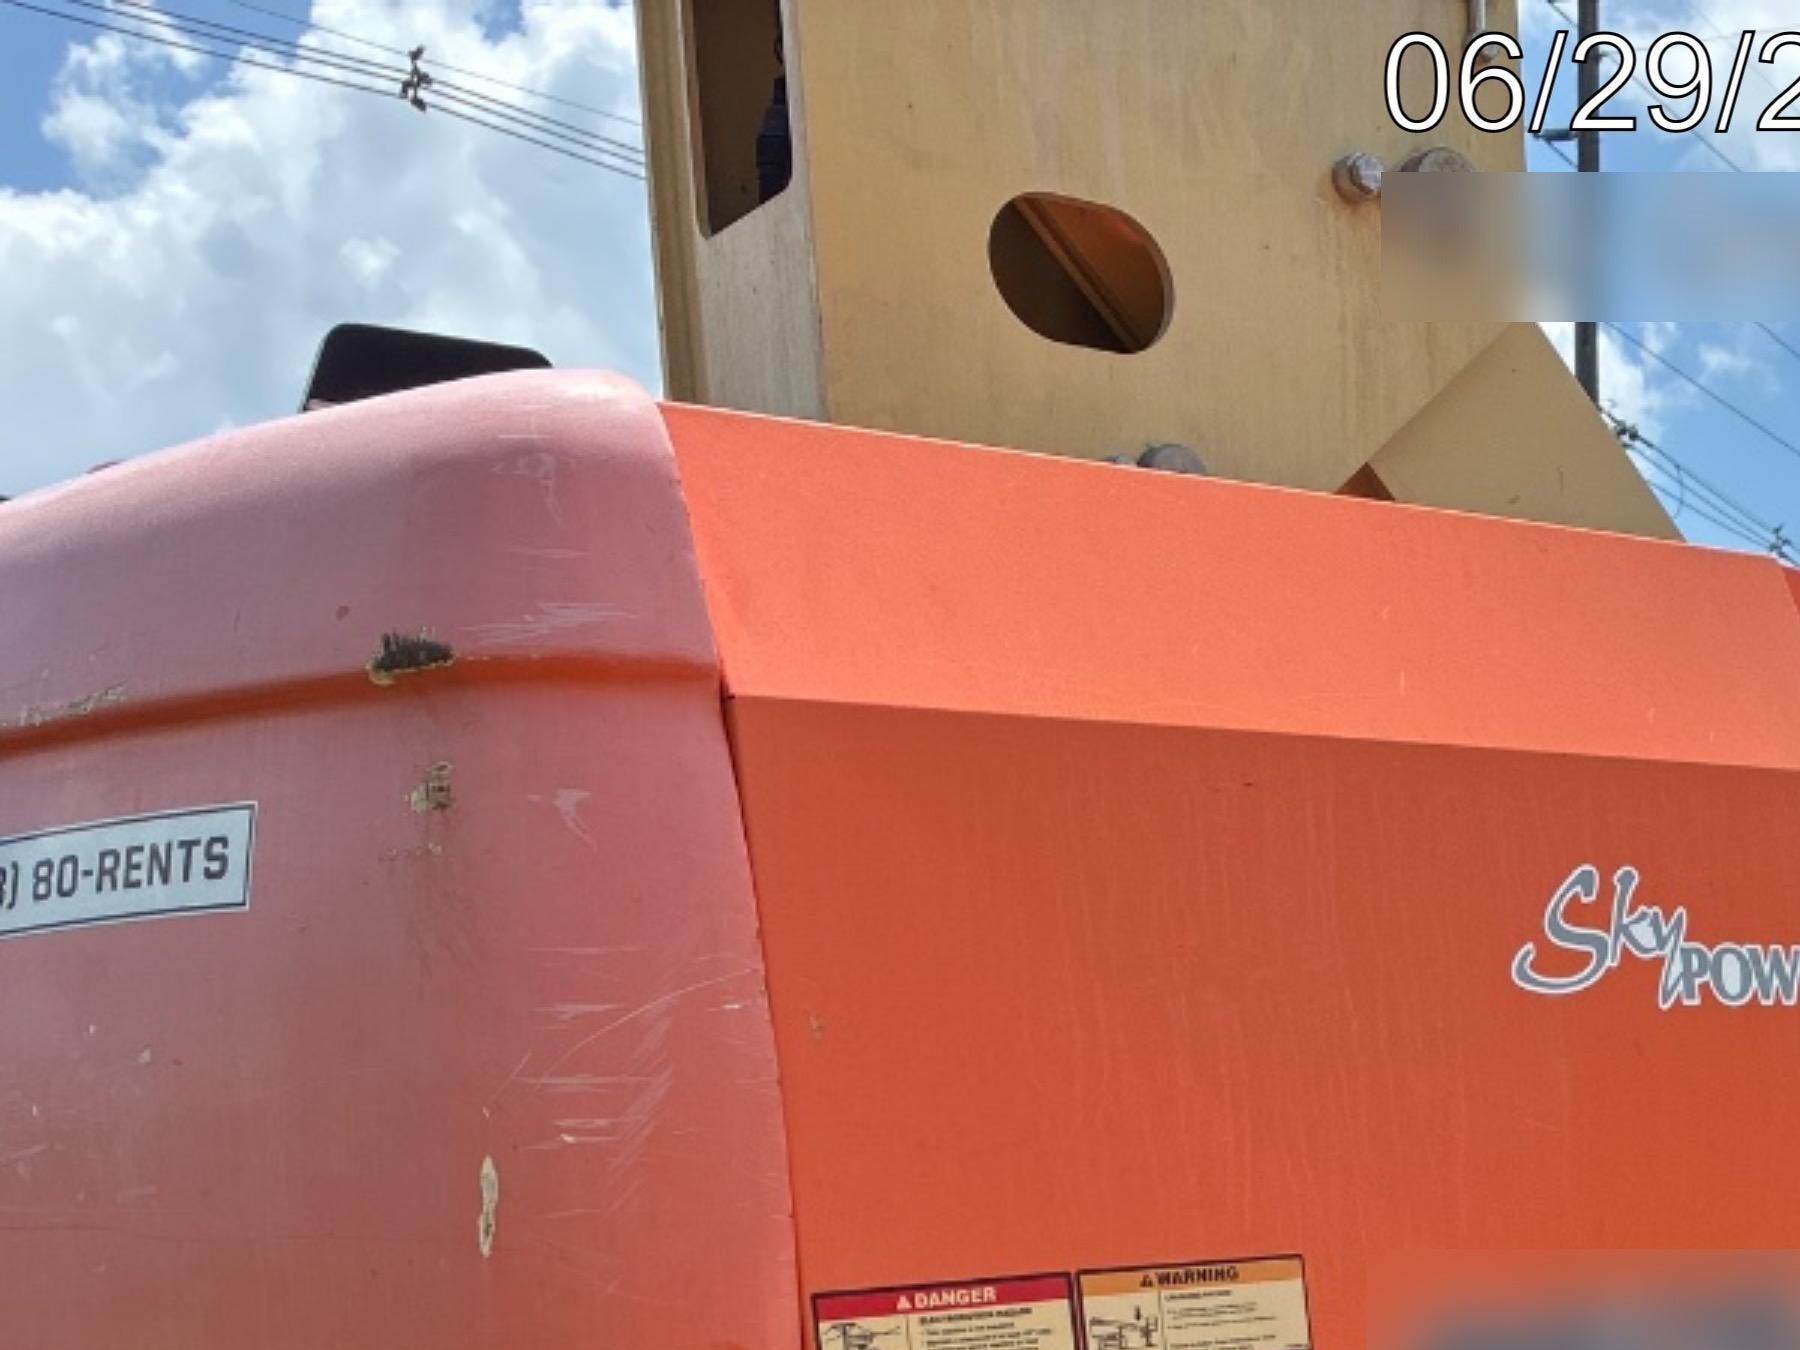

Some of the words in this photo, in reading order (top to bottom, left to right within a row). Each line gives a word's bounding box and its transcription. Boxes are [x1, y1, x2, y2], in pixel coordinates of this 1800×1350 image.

[32, 836, 229, 901] 80-RENTS
[1158, 1266, 1239, 1286] WARNING
[914, 1286, 996, 1309] DANGER
